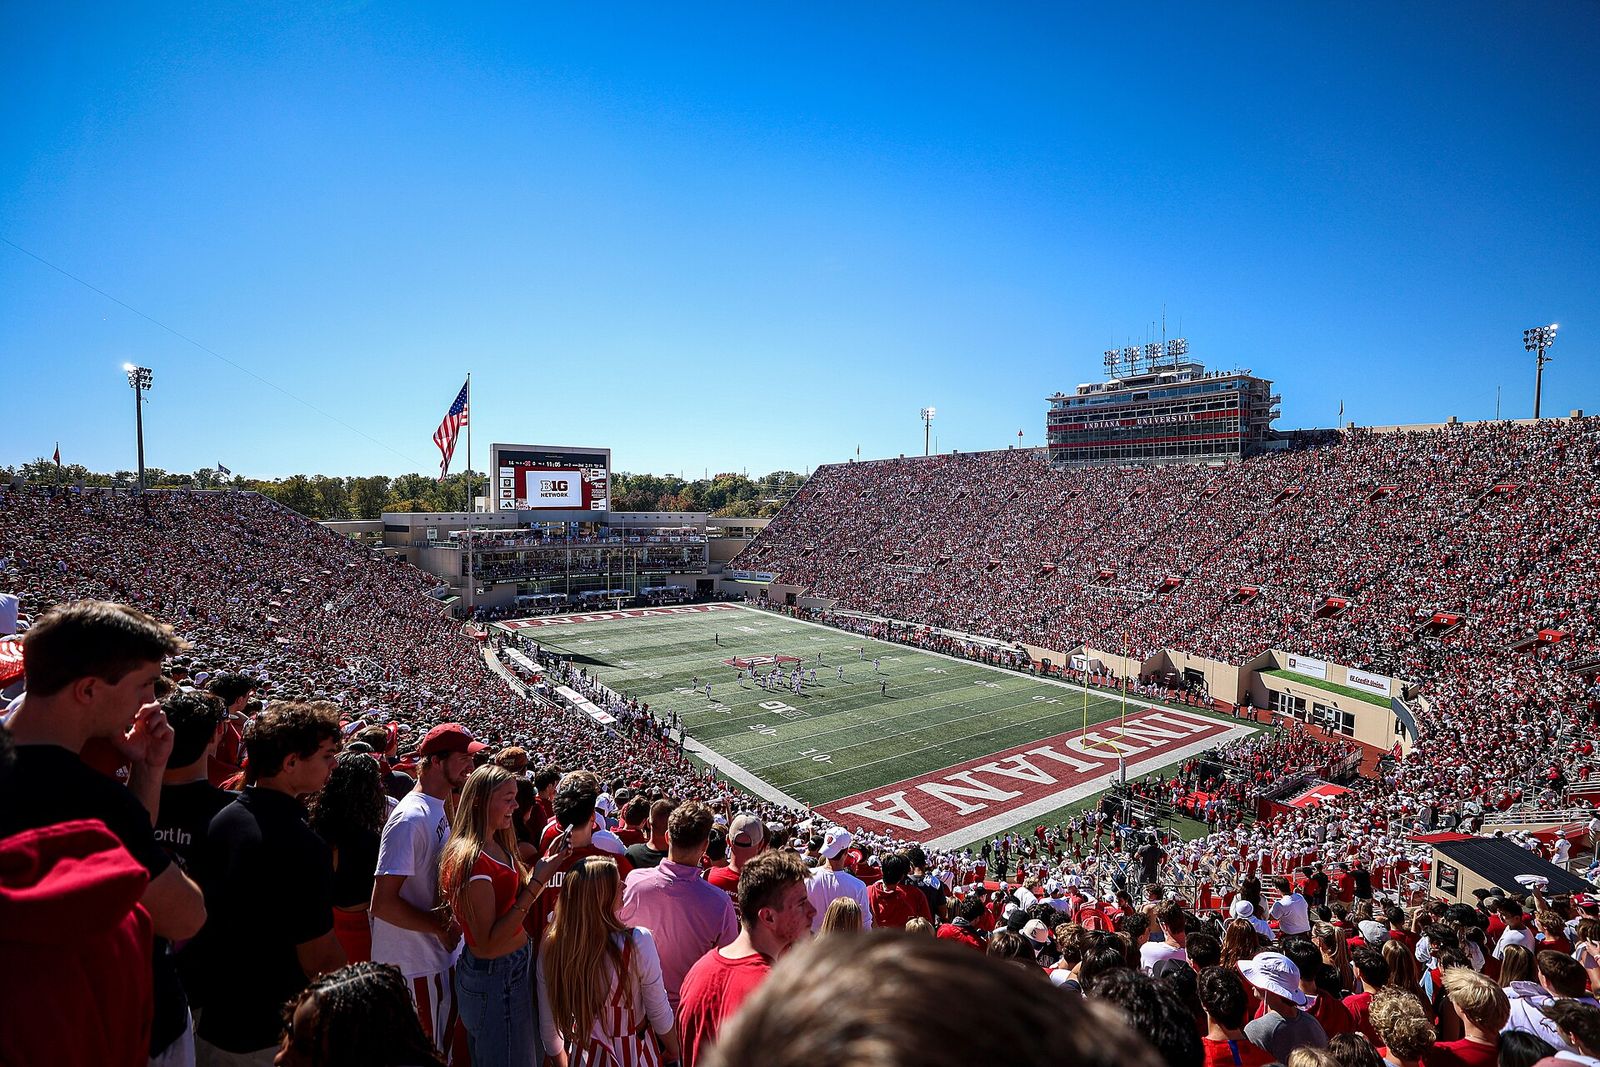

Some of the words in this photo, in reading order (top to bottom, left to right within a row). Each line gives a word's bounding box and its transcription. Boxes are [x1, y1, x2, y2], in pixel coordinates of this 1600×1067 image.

[1084, 420, 1121, 430] INDIANA
[1137, 414, 1196, 425] UNIVERSITY
[515, 605, 737, 628] INDIANA
[798, 748, 831, 762] 10
[836, 712, 1213, 832] INDIANA
[176, 828, 192, 845] In
